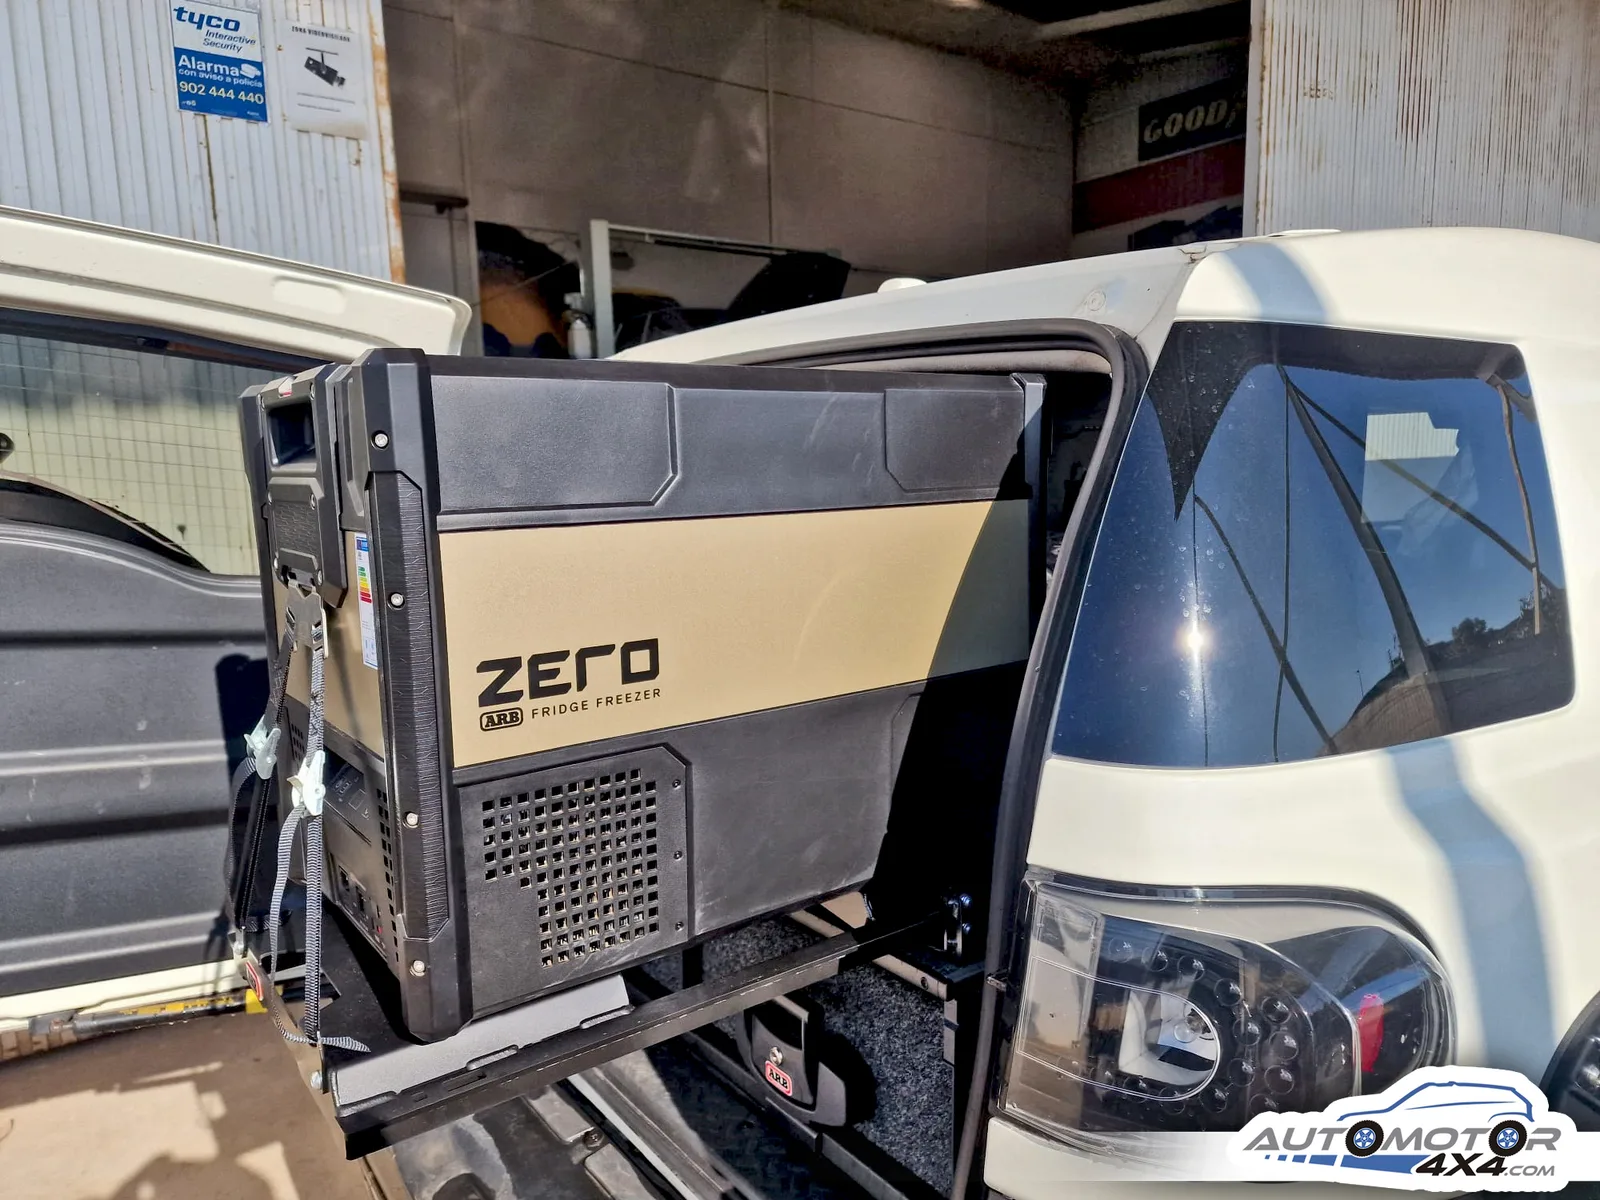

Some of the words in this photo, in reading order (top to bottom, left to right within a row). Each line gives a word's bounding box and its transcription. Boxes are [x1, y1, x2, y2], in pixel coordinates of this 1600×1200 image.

[173, 6, 241, 32] tyco
[202, 38, 243, 53] Security
[205, 29, 256, 45] Interactive
[178, 54, 240, 77] Alarma
[178, 68, 197, 77] con
[198, 72, 224, 82] aviso
[179, 81, 206, 96] 902
[208, 86, 235, 100] 444
[237, 91, 264, 104] 440
[476, 638, 660, 708] ZERO
[484, 711, 520, 728] ARB
[531, 700, 589, 719] FRIDGE
[596, 688, 661, 708] FREEZER
[768, 1068, 789, 1090] ARB
